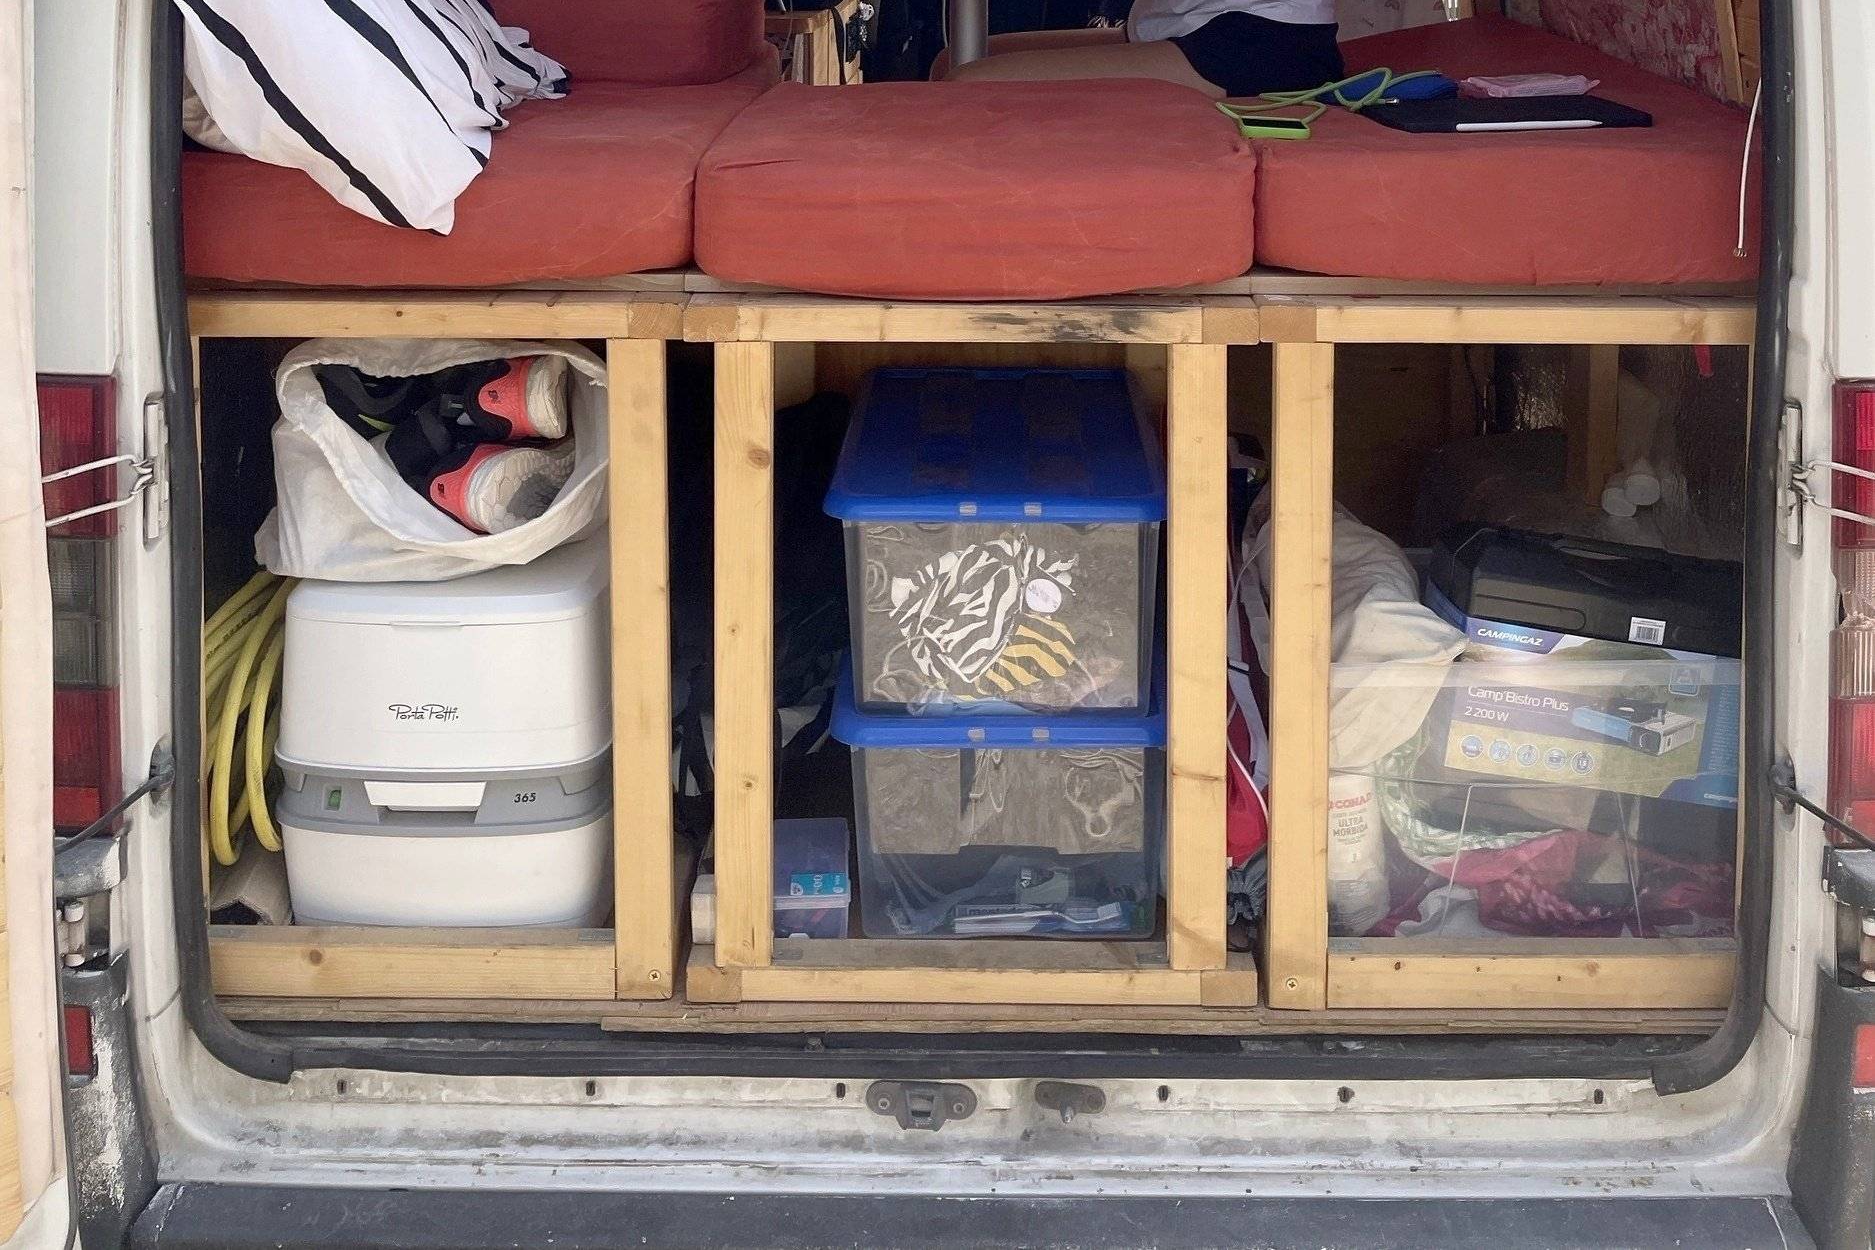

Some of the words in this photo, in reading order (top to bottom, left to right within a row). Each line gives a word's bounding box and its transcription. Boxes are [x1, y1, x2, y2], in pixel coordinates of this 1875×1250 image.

[1477, 628, 1545, 647] CAMPINGAZ
[388, 703, 425, 721] Porta
[1542, 696, 1569, 712] Plus
[1496, 711, 1510, 723] W
[513, 792, 537, 804] 365
